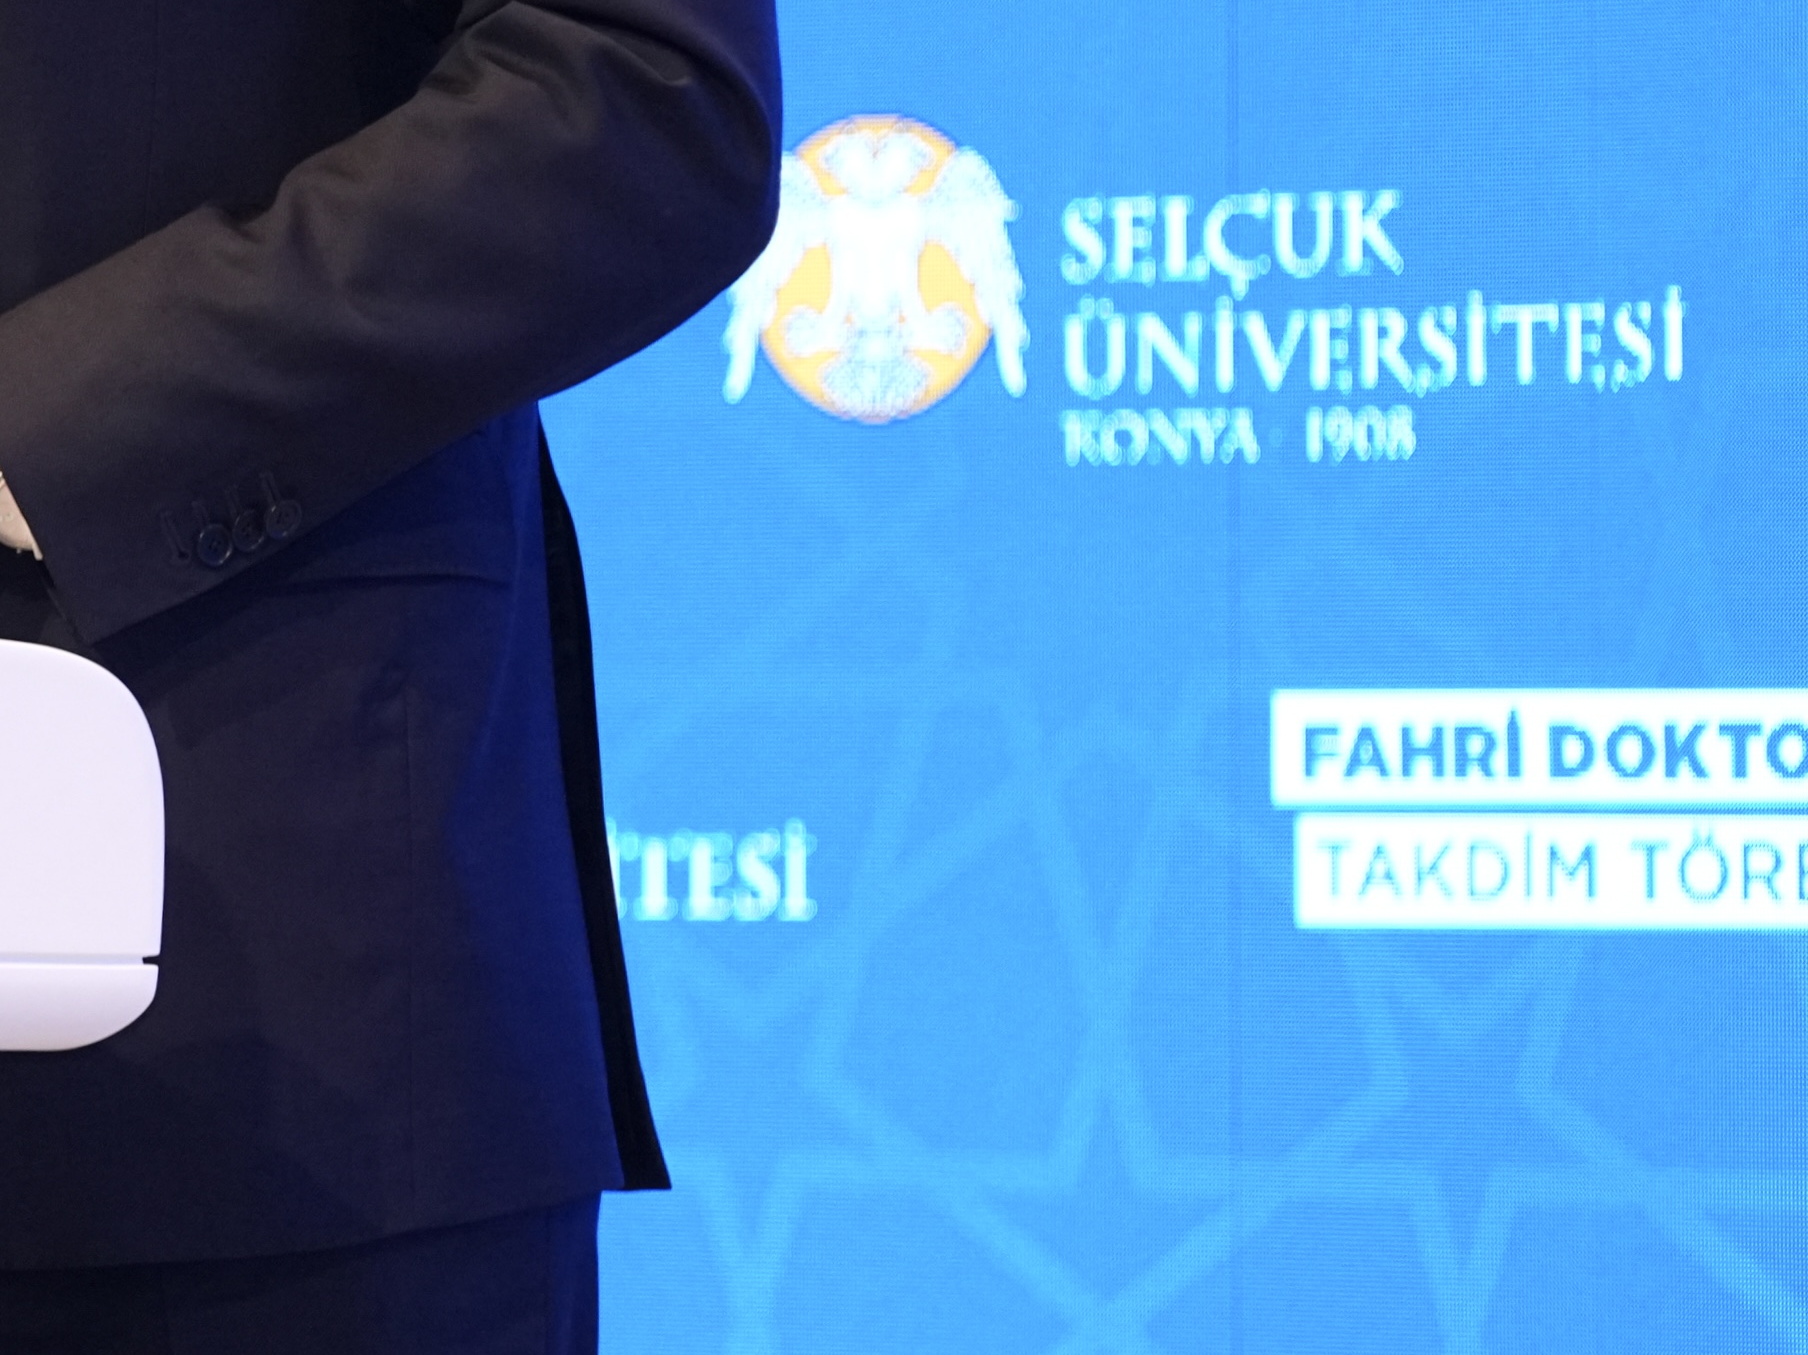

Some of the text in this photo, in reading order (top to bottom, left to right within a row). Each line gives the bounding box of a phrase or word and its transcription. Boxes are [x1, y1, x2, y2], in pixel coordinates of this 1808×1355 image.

[1061, 189, 1404, 300] SELÇUK
[1063, 285, 1687, 400] ÜNİVERSİTESİ
[1059, 405, 1417, 466] KONYA 1908
[1304, 707, 1808, 779] FAHRİ DOKTO
[1316, 824, 1808, 902] TAKDİM TÖR
